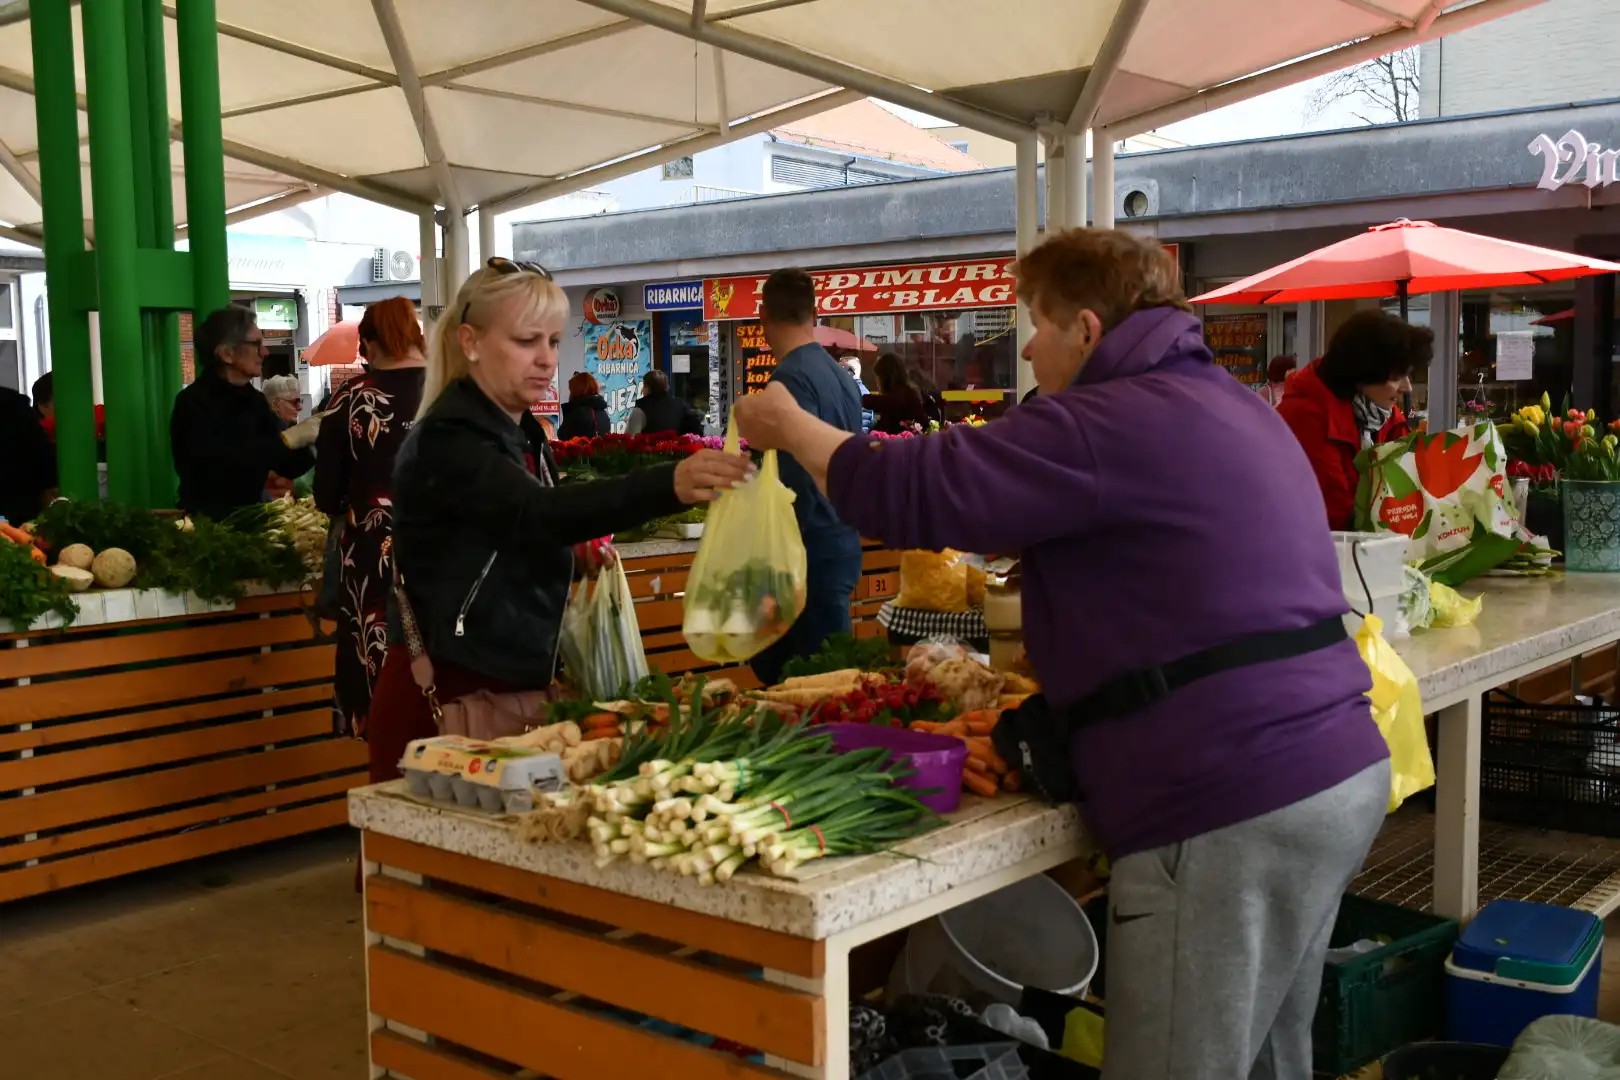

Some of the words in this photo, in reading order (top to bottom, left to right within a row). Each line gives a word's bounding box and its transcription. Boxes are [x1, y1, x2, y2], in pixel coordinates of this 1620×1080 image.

[647, 286, 704, 304] RIBARNICA
[736, 325, 764, 337] SVJ
[597, 336, 634, 360] Orka
[741, 337, 768, 348] ME
[598, 362, 639, 375] RIBARNICA
[1437, 526, 1470, 541] KONZUM
[875, 579, 888, 592] 31
